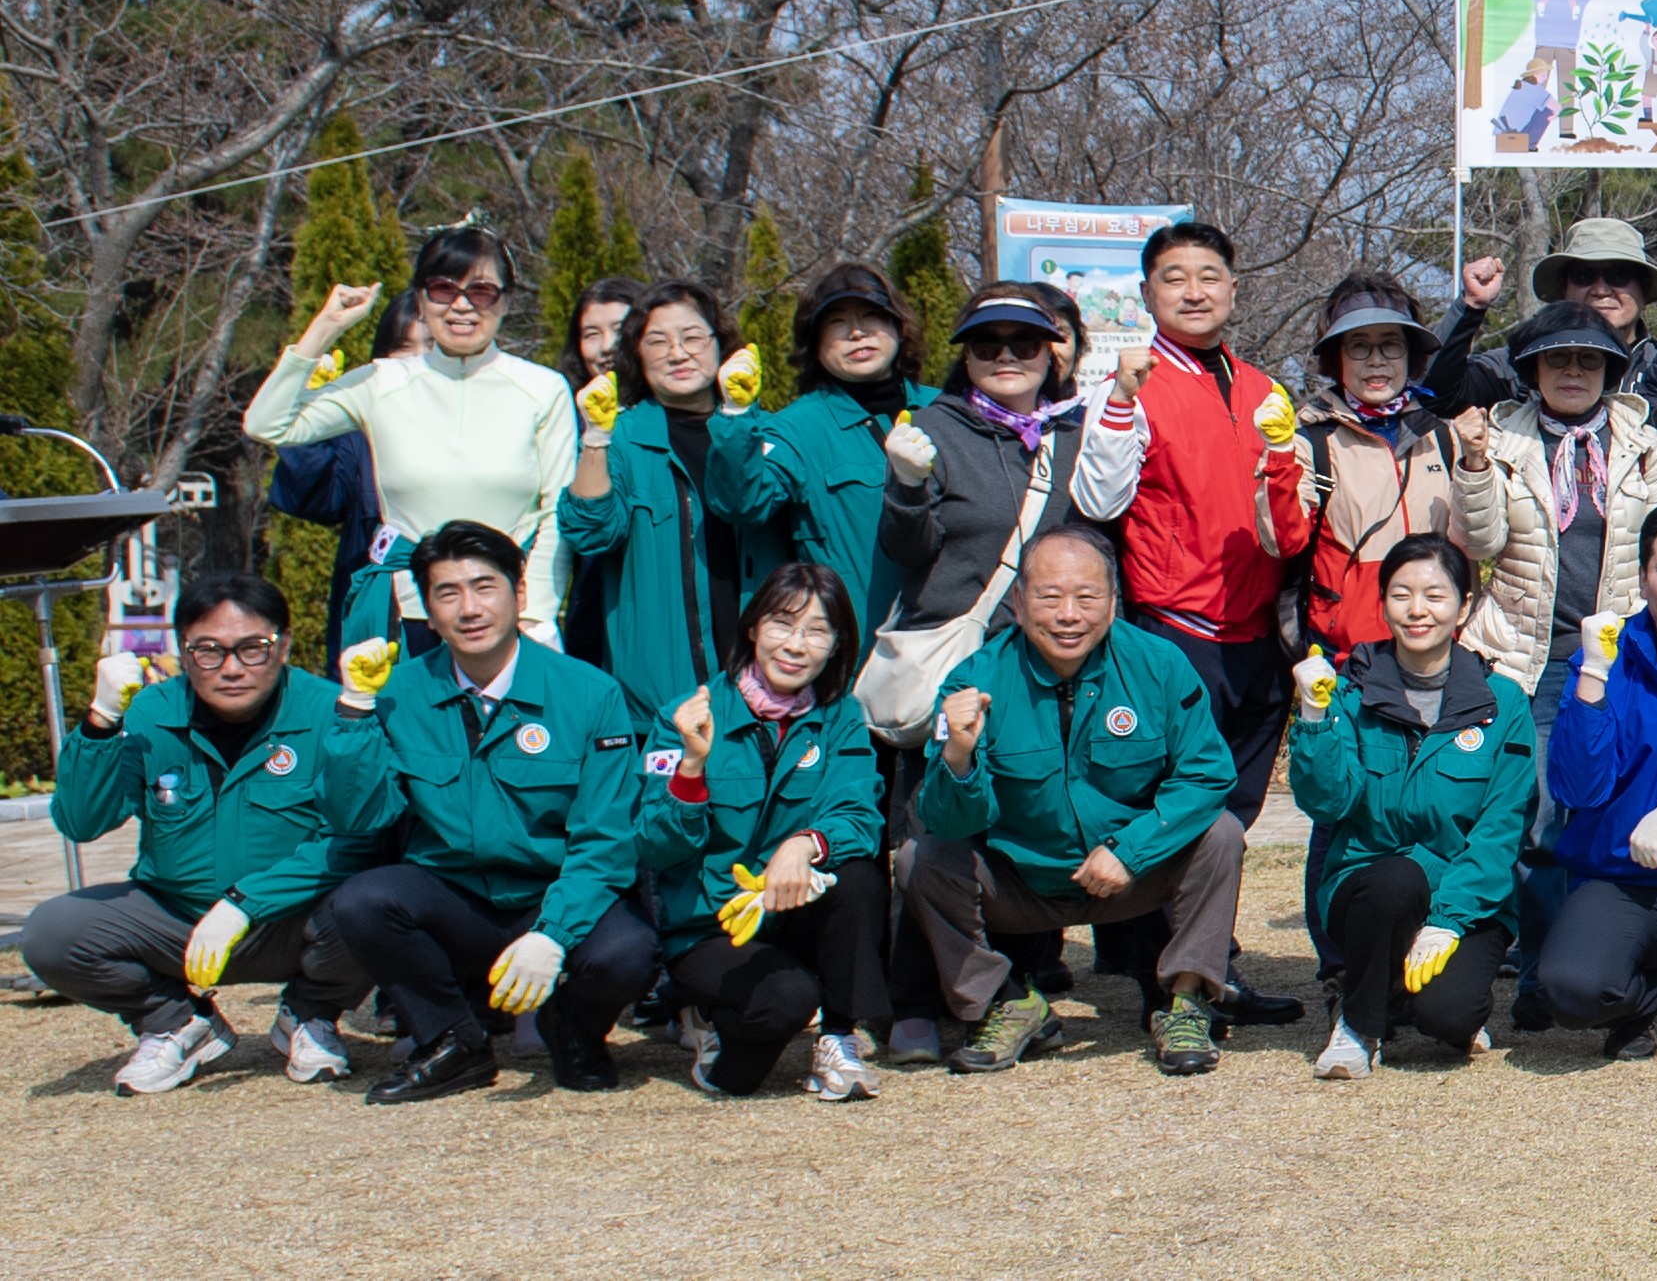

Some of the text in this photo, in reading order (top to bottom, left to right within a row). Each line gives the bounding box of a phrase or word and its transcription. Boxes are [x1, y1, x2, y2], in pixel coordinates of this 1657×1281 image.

[1026, 216, 1141, 236] 나무심기 요령
[1426, 464, 1442, 473] K2
